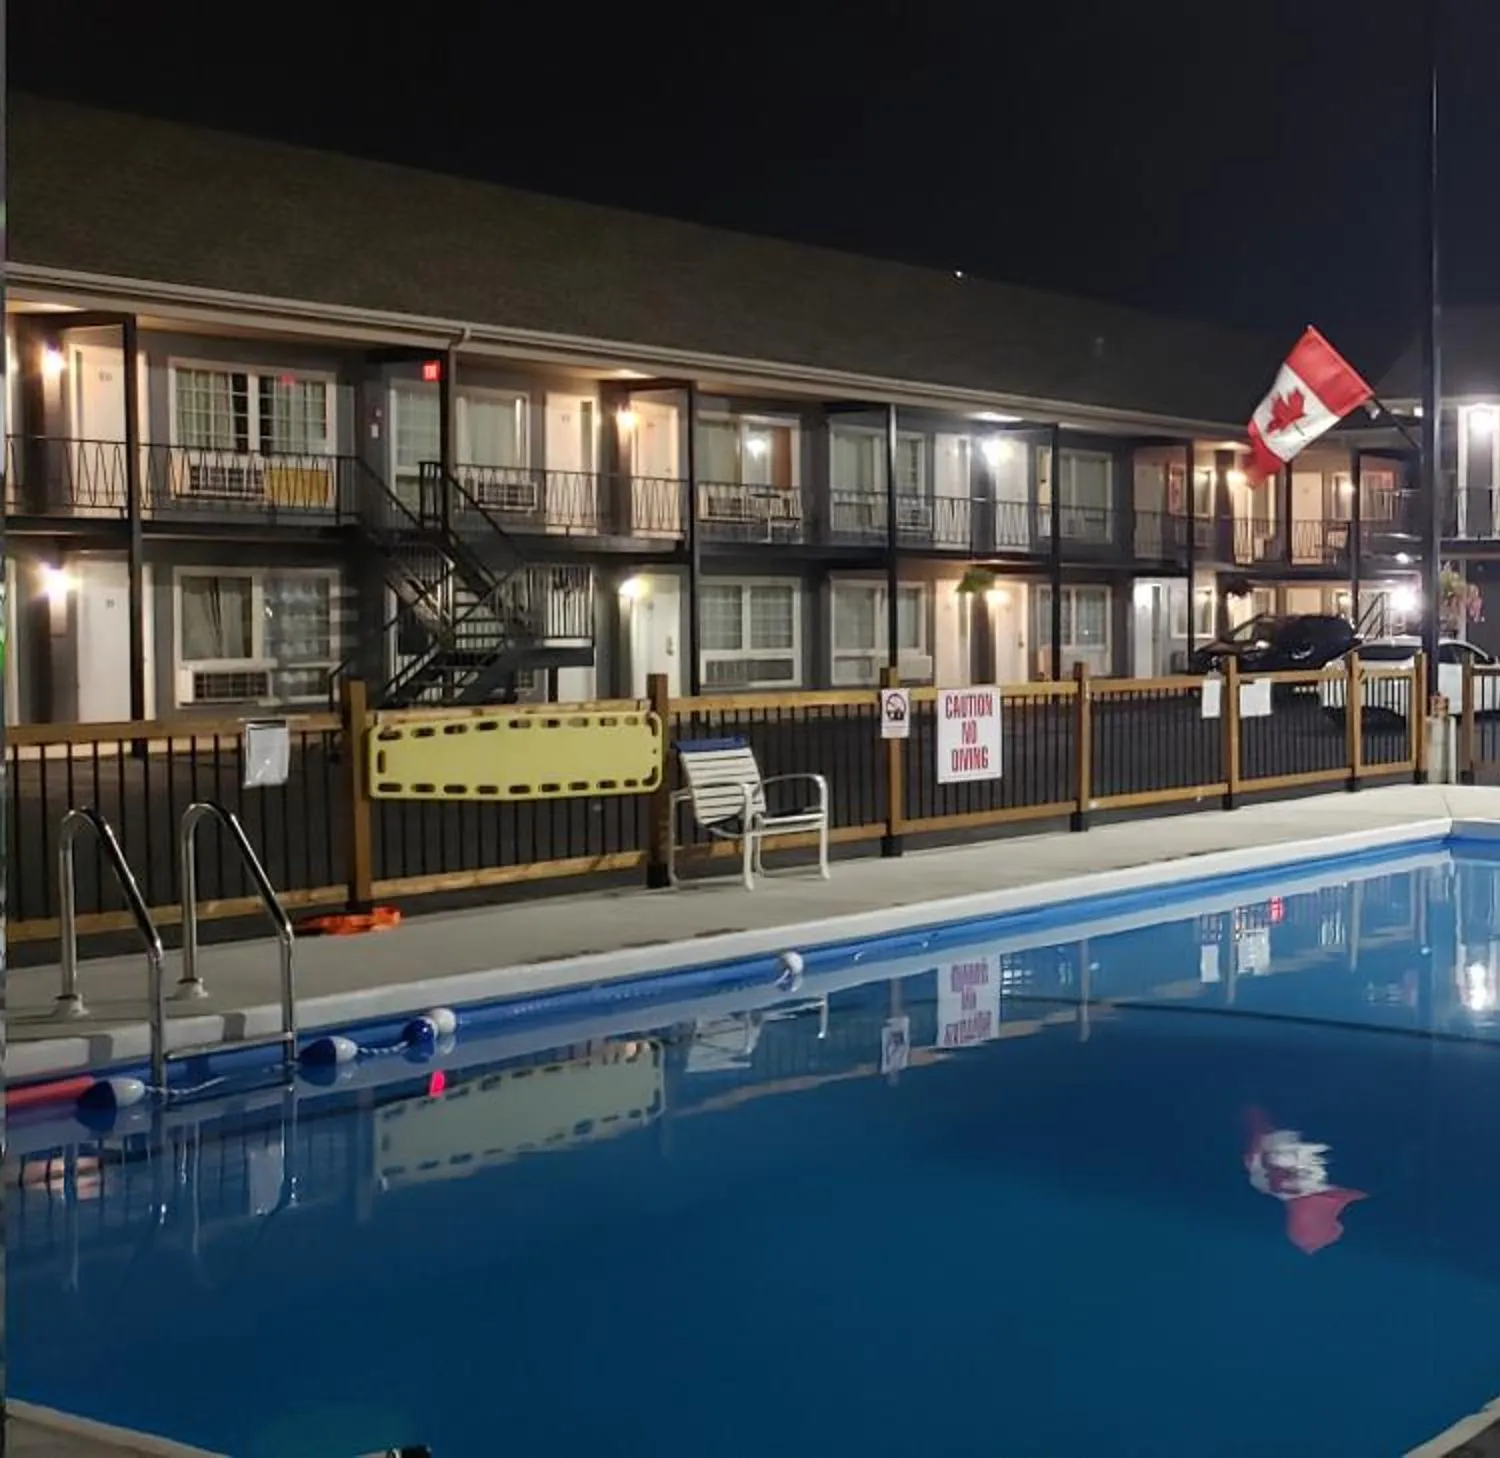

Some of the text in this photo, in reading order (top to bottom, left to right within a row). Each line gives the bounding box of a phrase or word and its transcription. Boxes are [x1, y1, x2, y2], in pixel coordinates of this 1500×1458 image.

[945, 693, 993, 719] CAUTION
[961, 719, 977, 745] NO
[951, 744, 989, 772] DIVING
